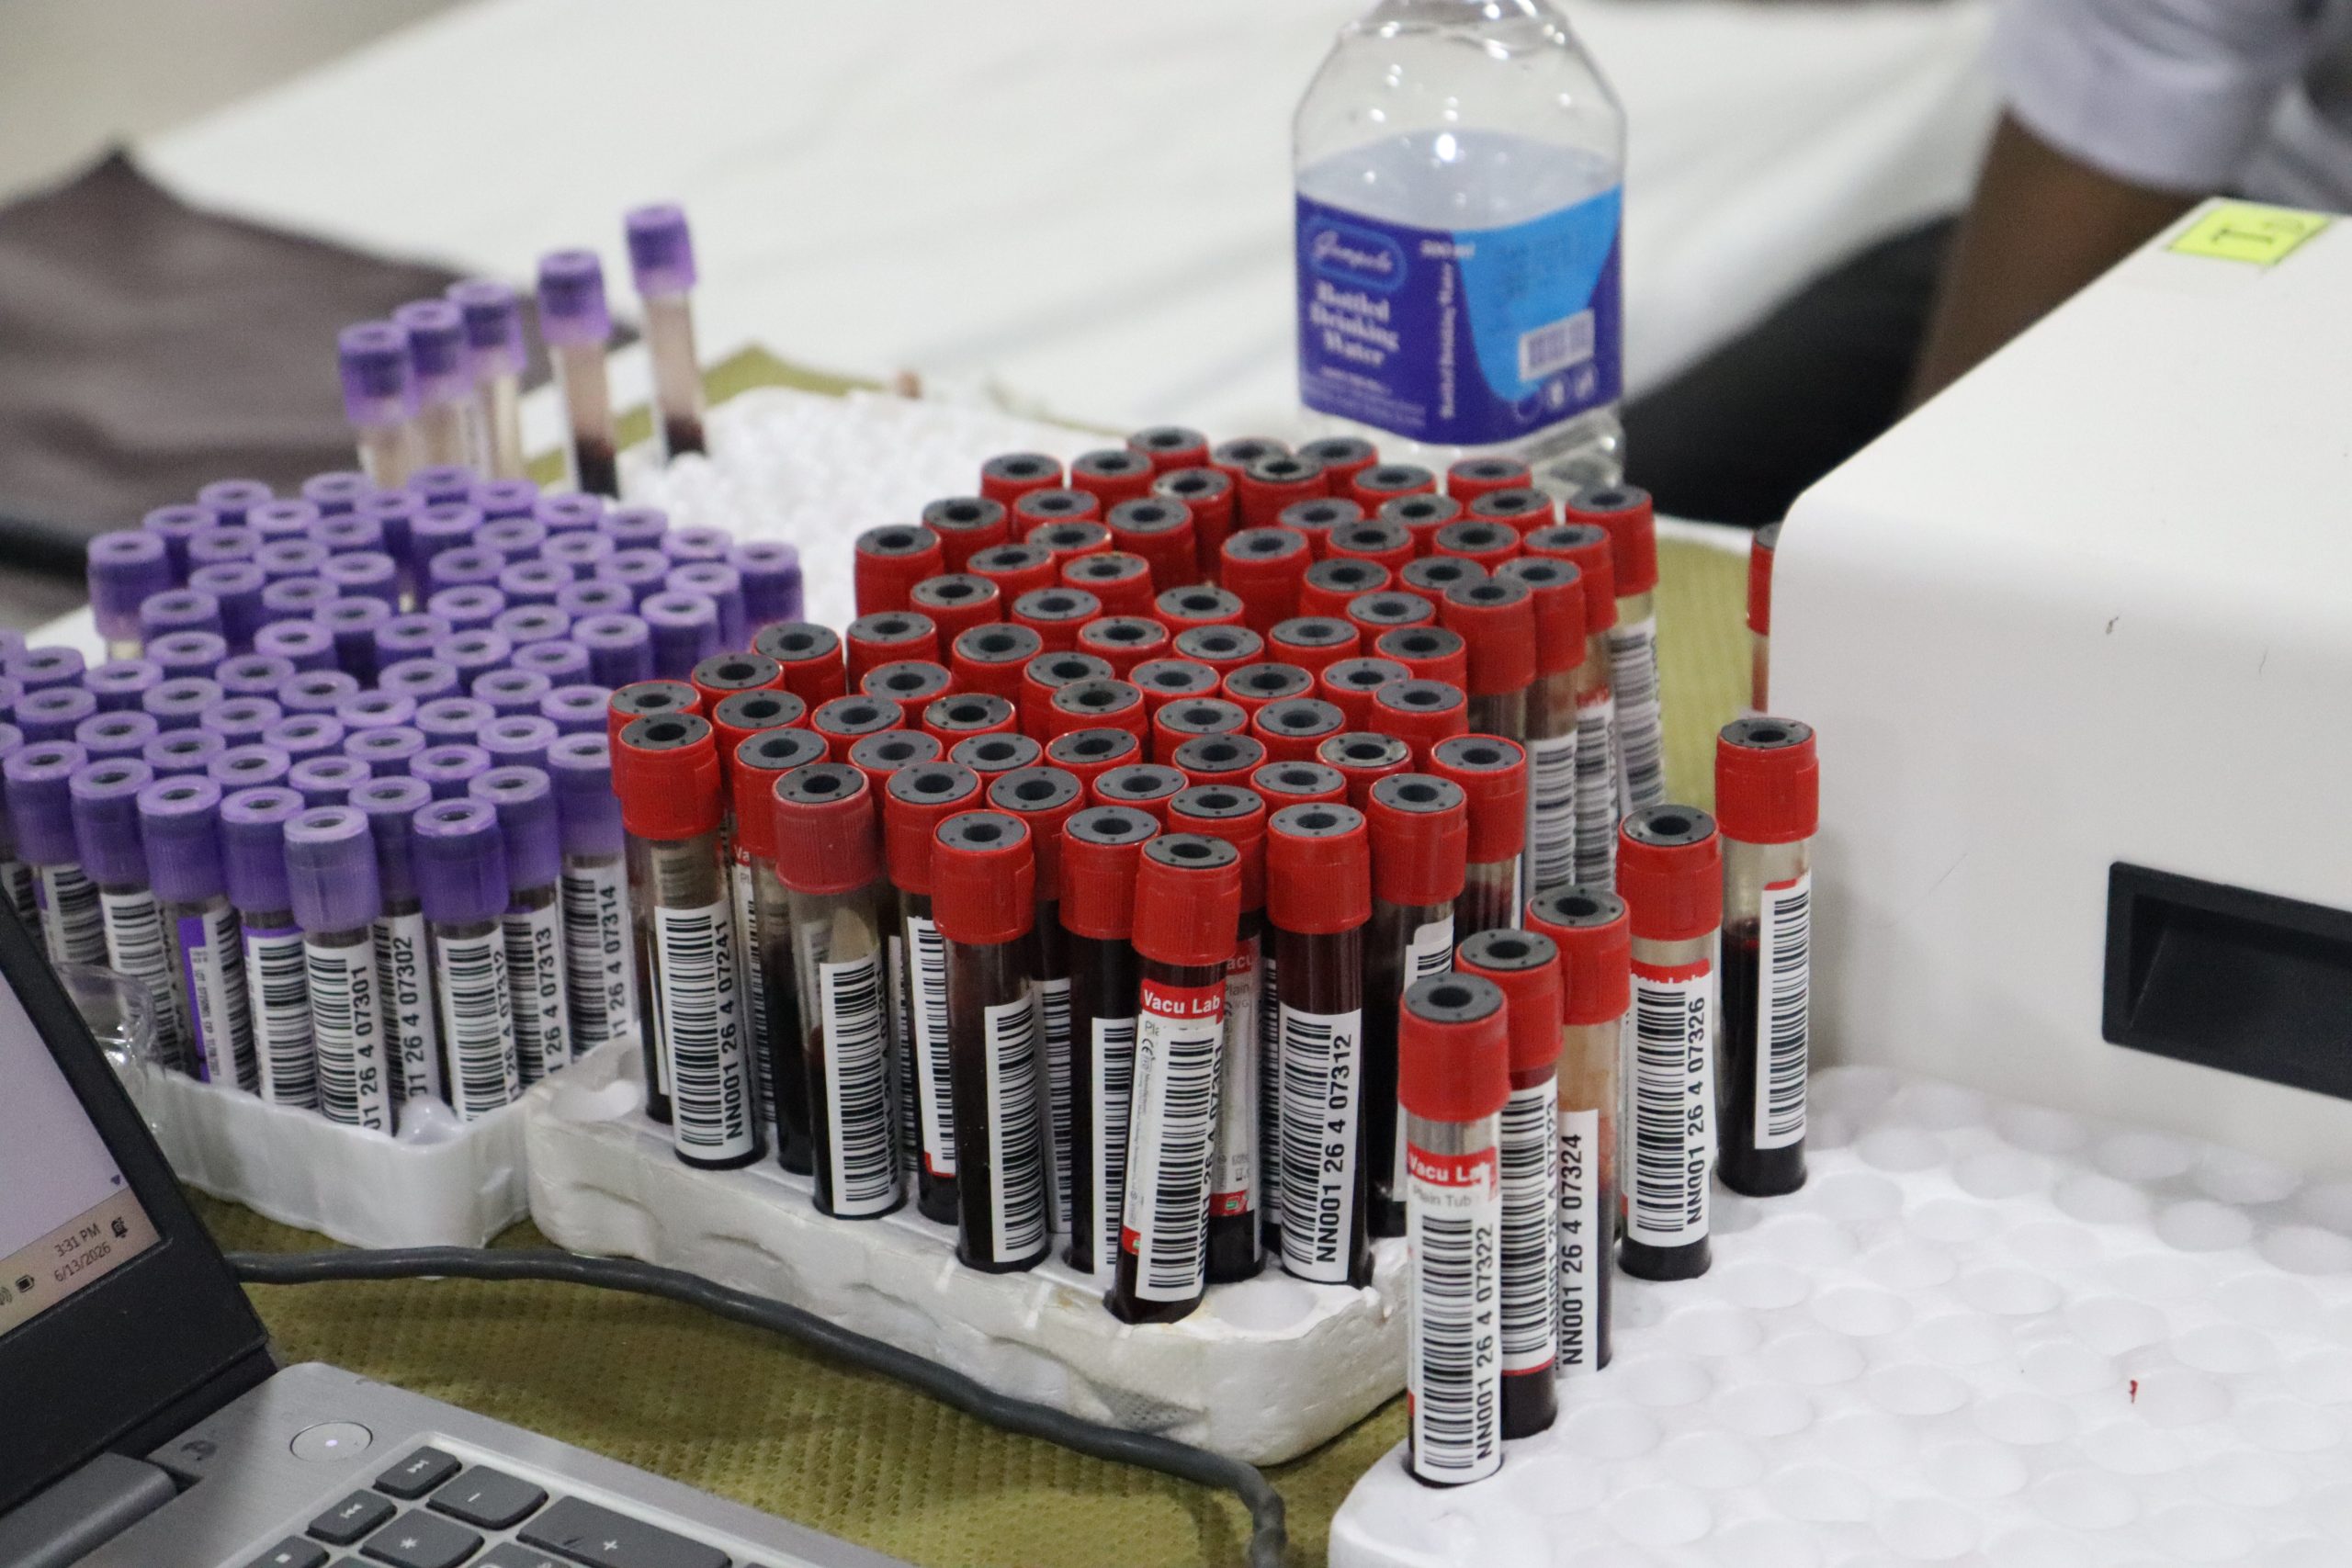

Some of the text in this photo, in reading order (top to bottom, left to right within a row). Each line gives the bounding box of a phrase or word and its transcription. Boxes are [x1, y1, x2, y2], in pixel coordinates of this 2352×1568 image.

[600, 886, 622, 954] 07314
[393, 935, 419, 1005] 07302
[536, 927, 557, 998] 07313
[606, 961, 622, 975] 4
[351, 966, 372, 1036] 07301
[543, 1006, 558, 1018] 4
[609, 982, 627, 1010] 26
[1143, 989, 1185, 1014] Vacu
[1193, 995, 1220, 1012] Lab
[402, 1014, 420, 1026] 4
[715, 920, 742, 1141] 07241 4 26 NN001
[357, 1043, 374, 1057] 4
[403, 1035, 424, 1064] 26
[545, 1026, 562, 1055] 26
[359, 1066, 378, 1096] 26
[1687, 997, 1705, 1224] 07326 4 26 NN001
[1317, 1034, 1351, 1262] 07312 4 26 NN001
[1409, 1153, 1449, 1181] Vacu
[1445, 1194, 1473, 1208] Tub
[54, 1223, 101, 1258] 3:31 PM
[1562, 1134, 1583, 1365] 07324 4 26 NN001
[54, 1241, 111, 1281] 6/13/2026
[1476, 1223, 1493, 1461] 07322 4 26 NN001
